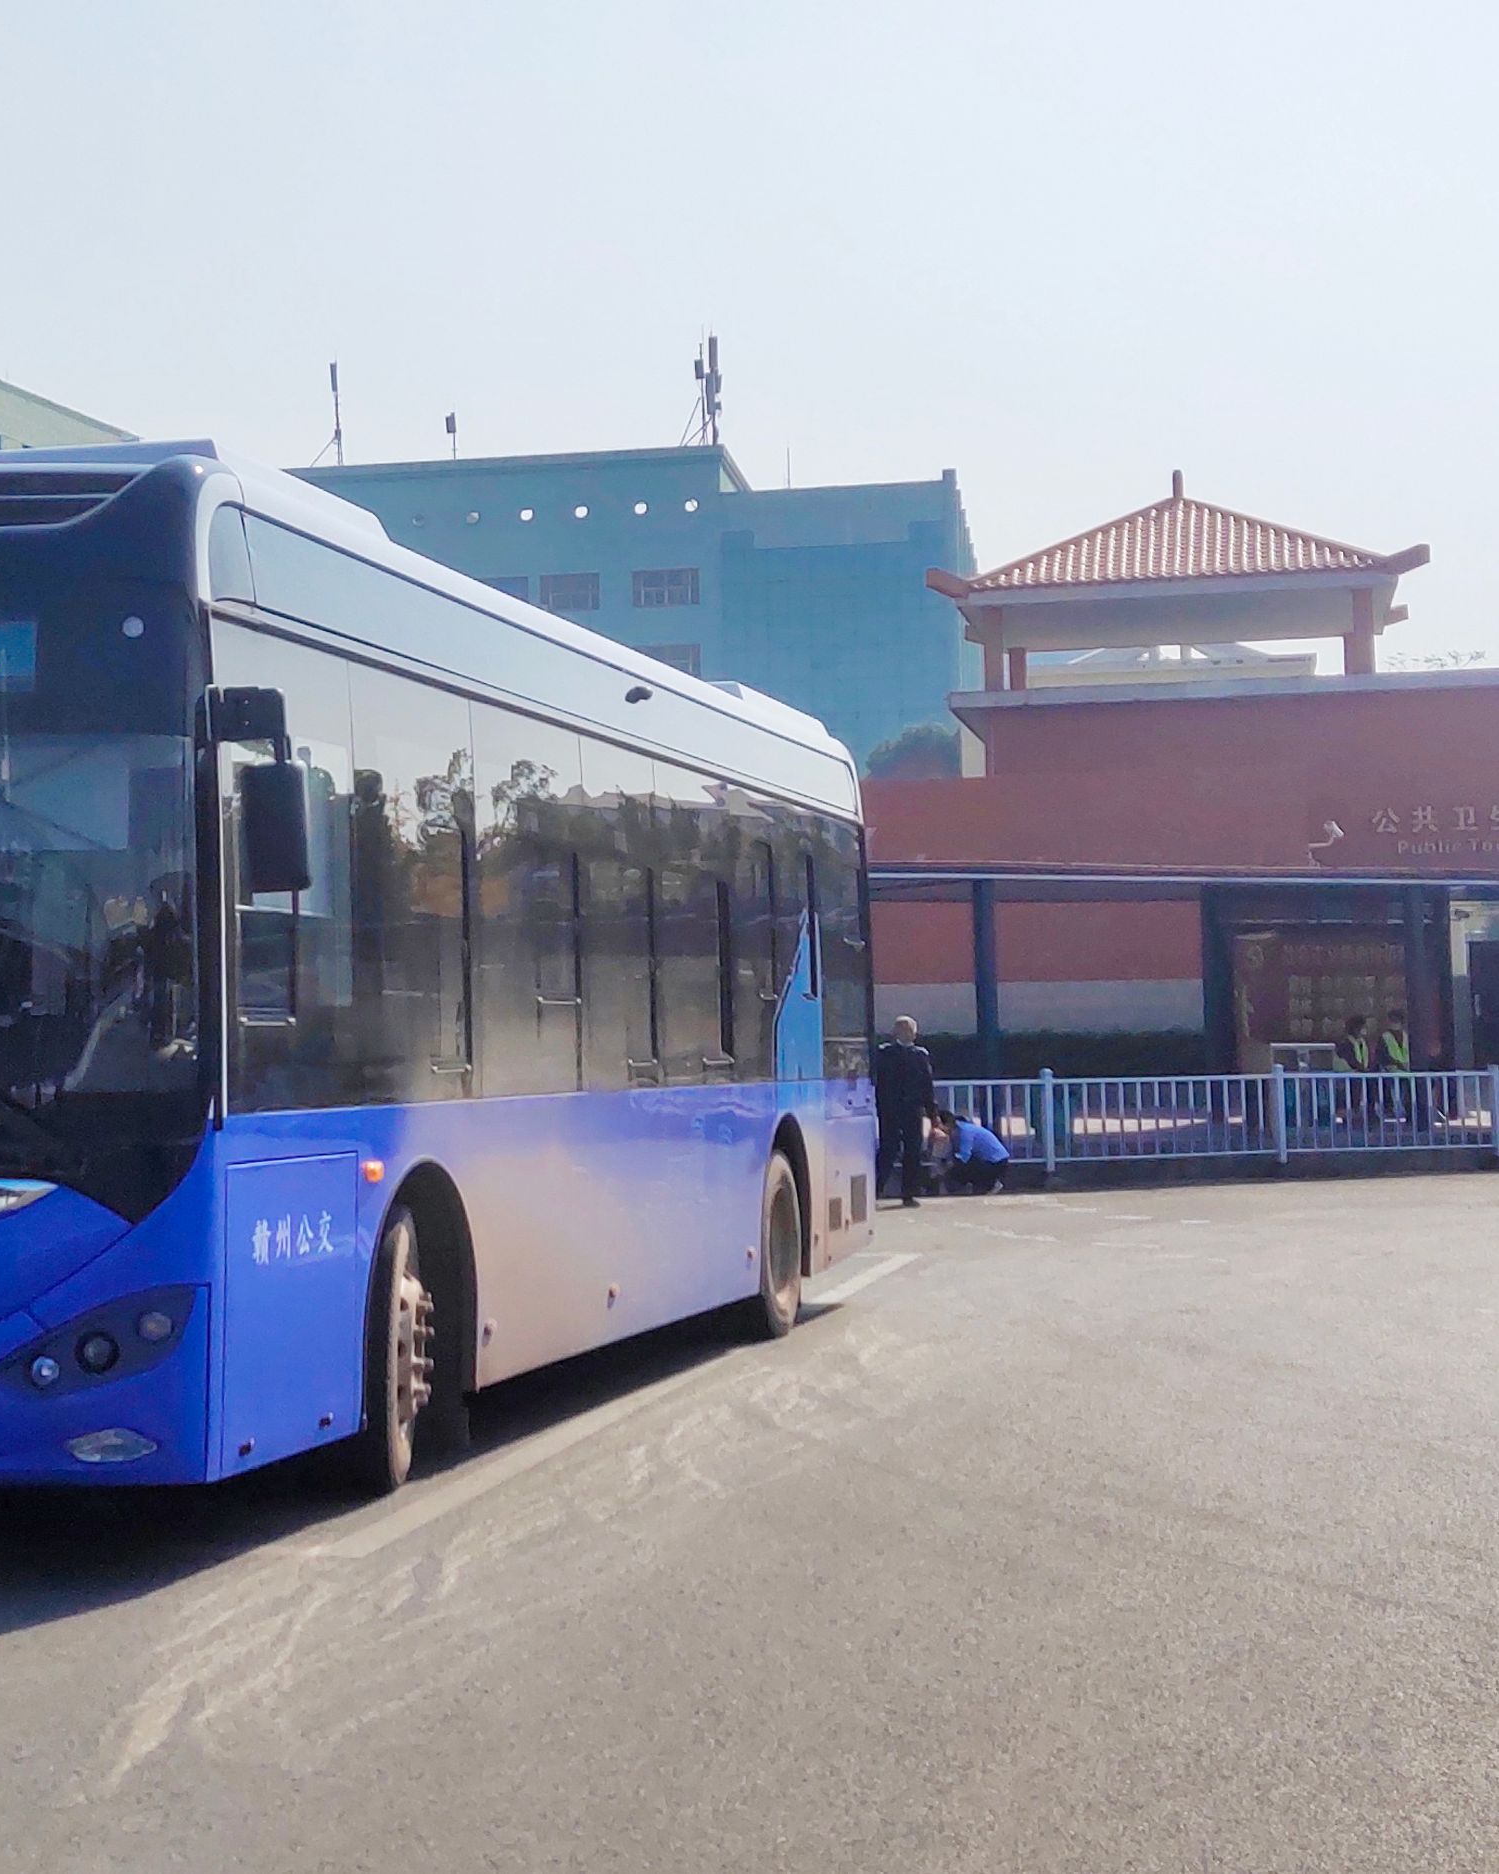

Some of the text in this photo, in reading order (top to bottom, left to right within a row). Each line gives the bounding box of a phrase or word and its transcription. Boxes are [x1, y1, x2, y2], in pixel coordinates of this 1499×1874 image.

[1467, 838, 1499, 852] To
[251, 1209, 334, 1265] 赣州公交
